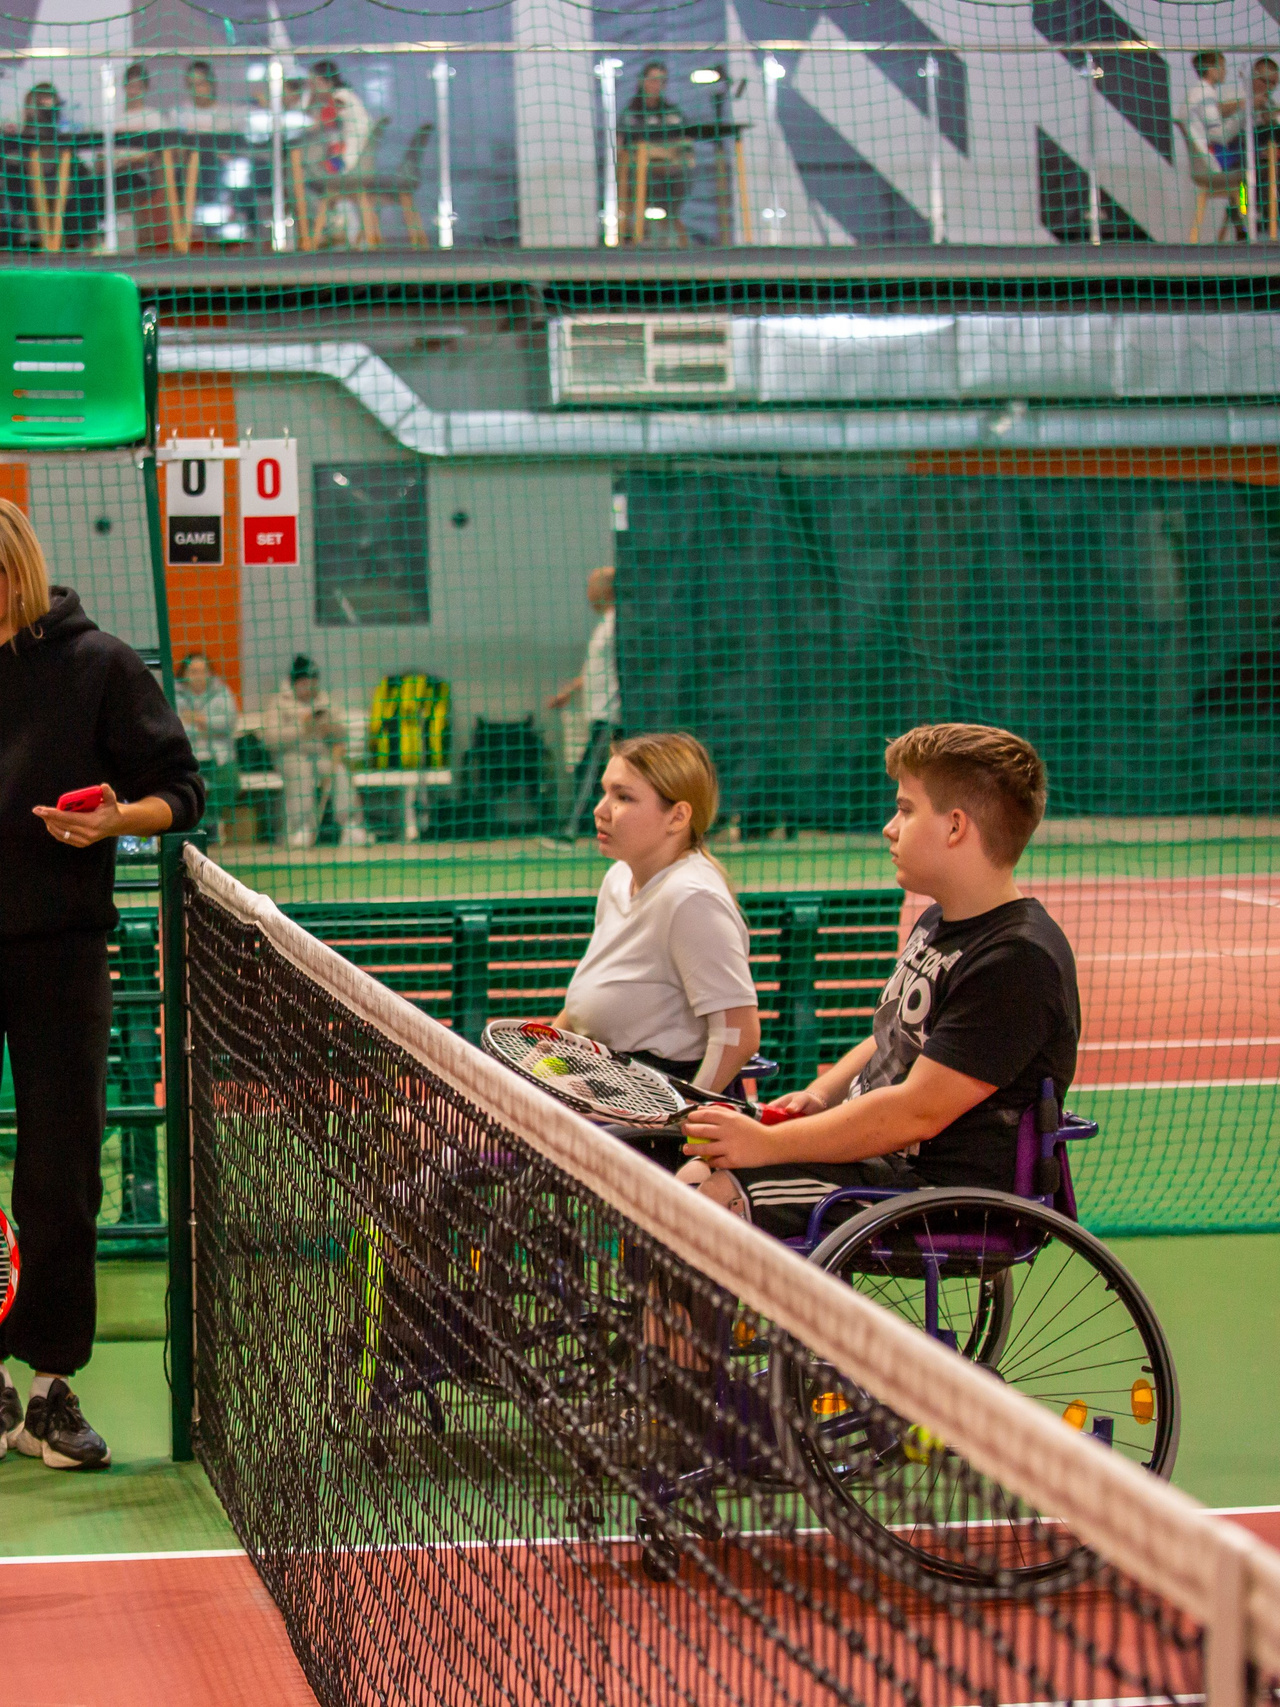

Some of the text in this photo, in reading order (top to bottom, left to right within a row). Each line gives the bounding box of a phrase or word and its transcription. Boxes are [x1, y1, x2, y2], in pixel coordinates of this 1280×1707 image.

[256, 458, 281, 500] 0
[174, 531, 216, 546] GAME
[256, 532, 284, 546] SET
